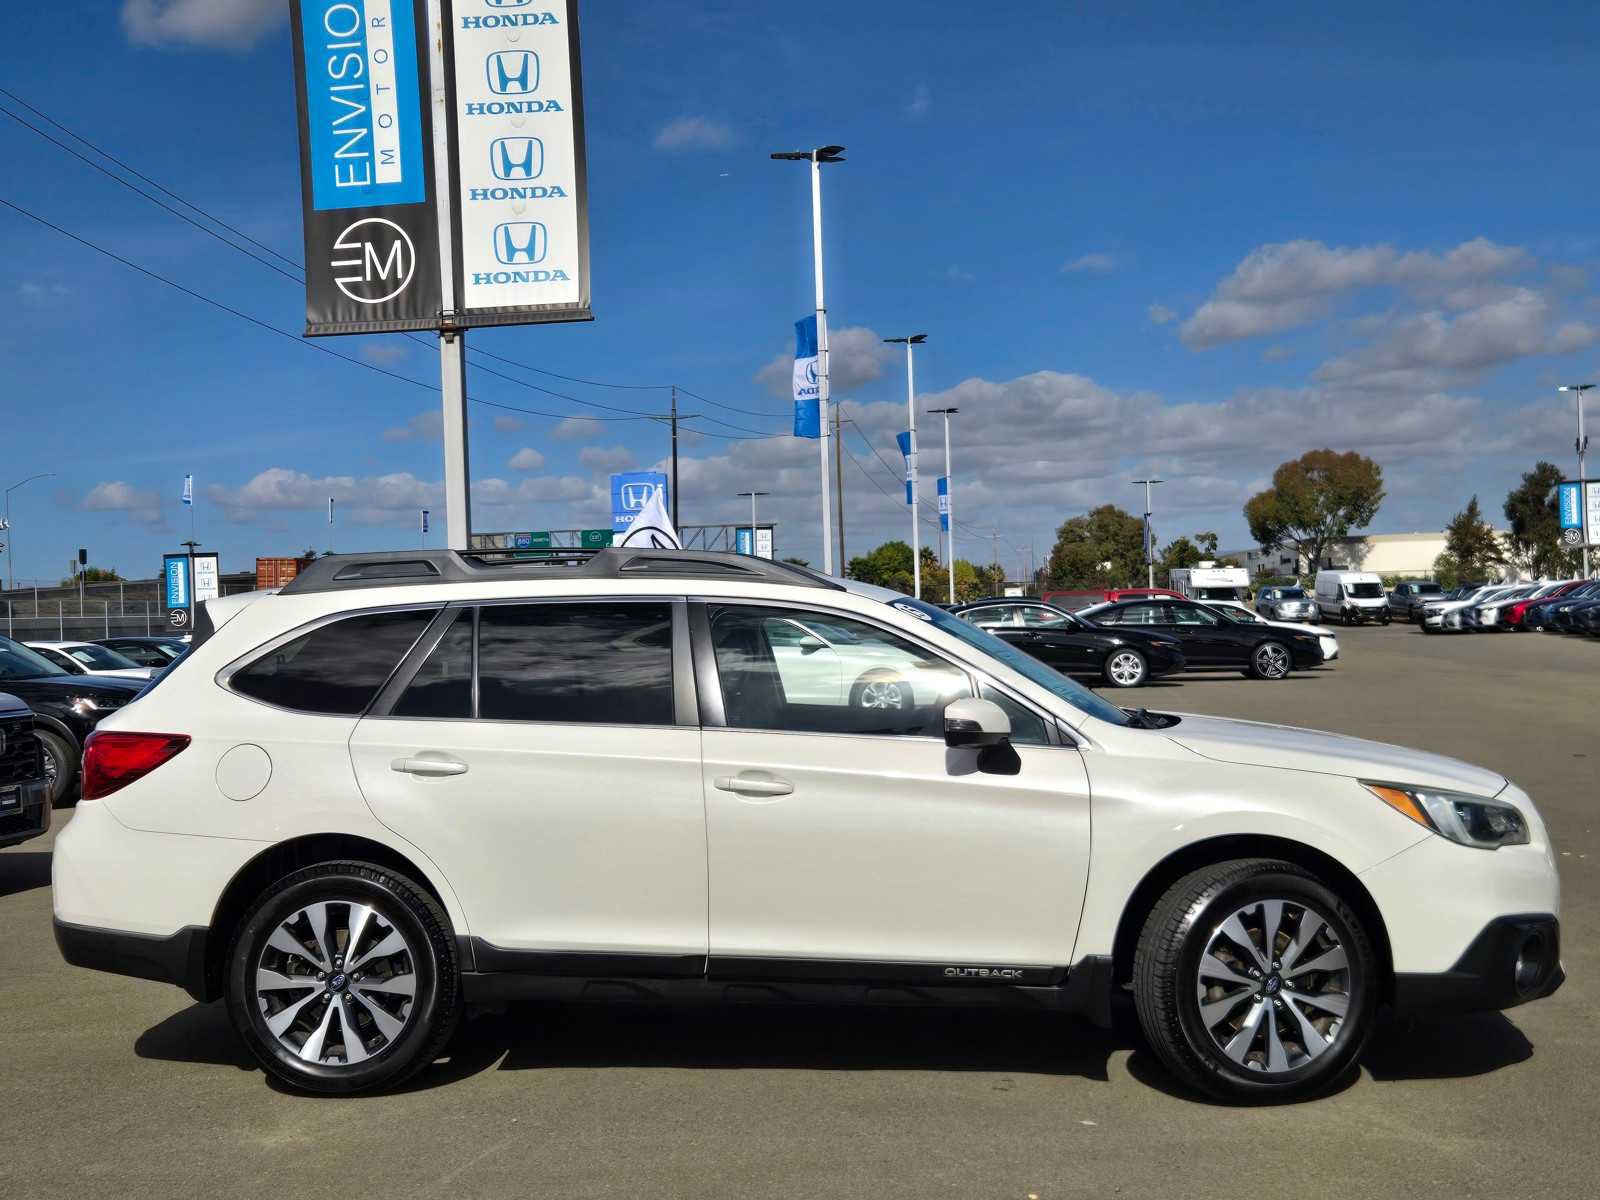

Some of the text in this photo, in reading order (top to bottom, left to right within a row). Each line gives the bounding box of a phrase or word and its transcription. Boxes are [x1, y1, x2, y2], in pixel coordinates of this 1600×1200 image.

[461, 12, 560, 29] HONDA
[465, 99, 564, 116] HONDA
[469, 185, 568, 201] HONDA
[471, 269, 571, 285] HONDA
[944, 967, 1024, 978] OUTBACK
